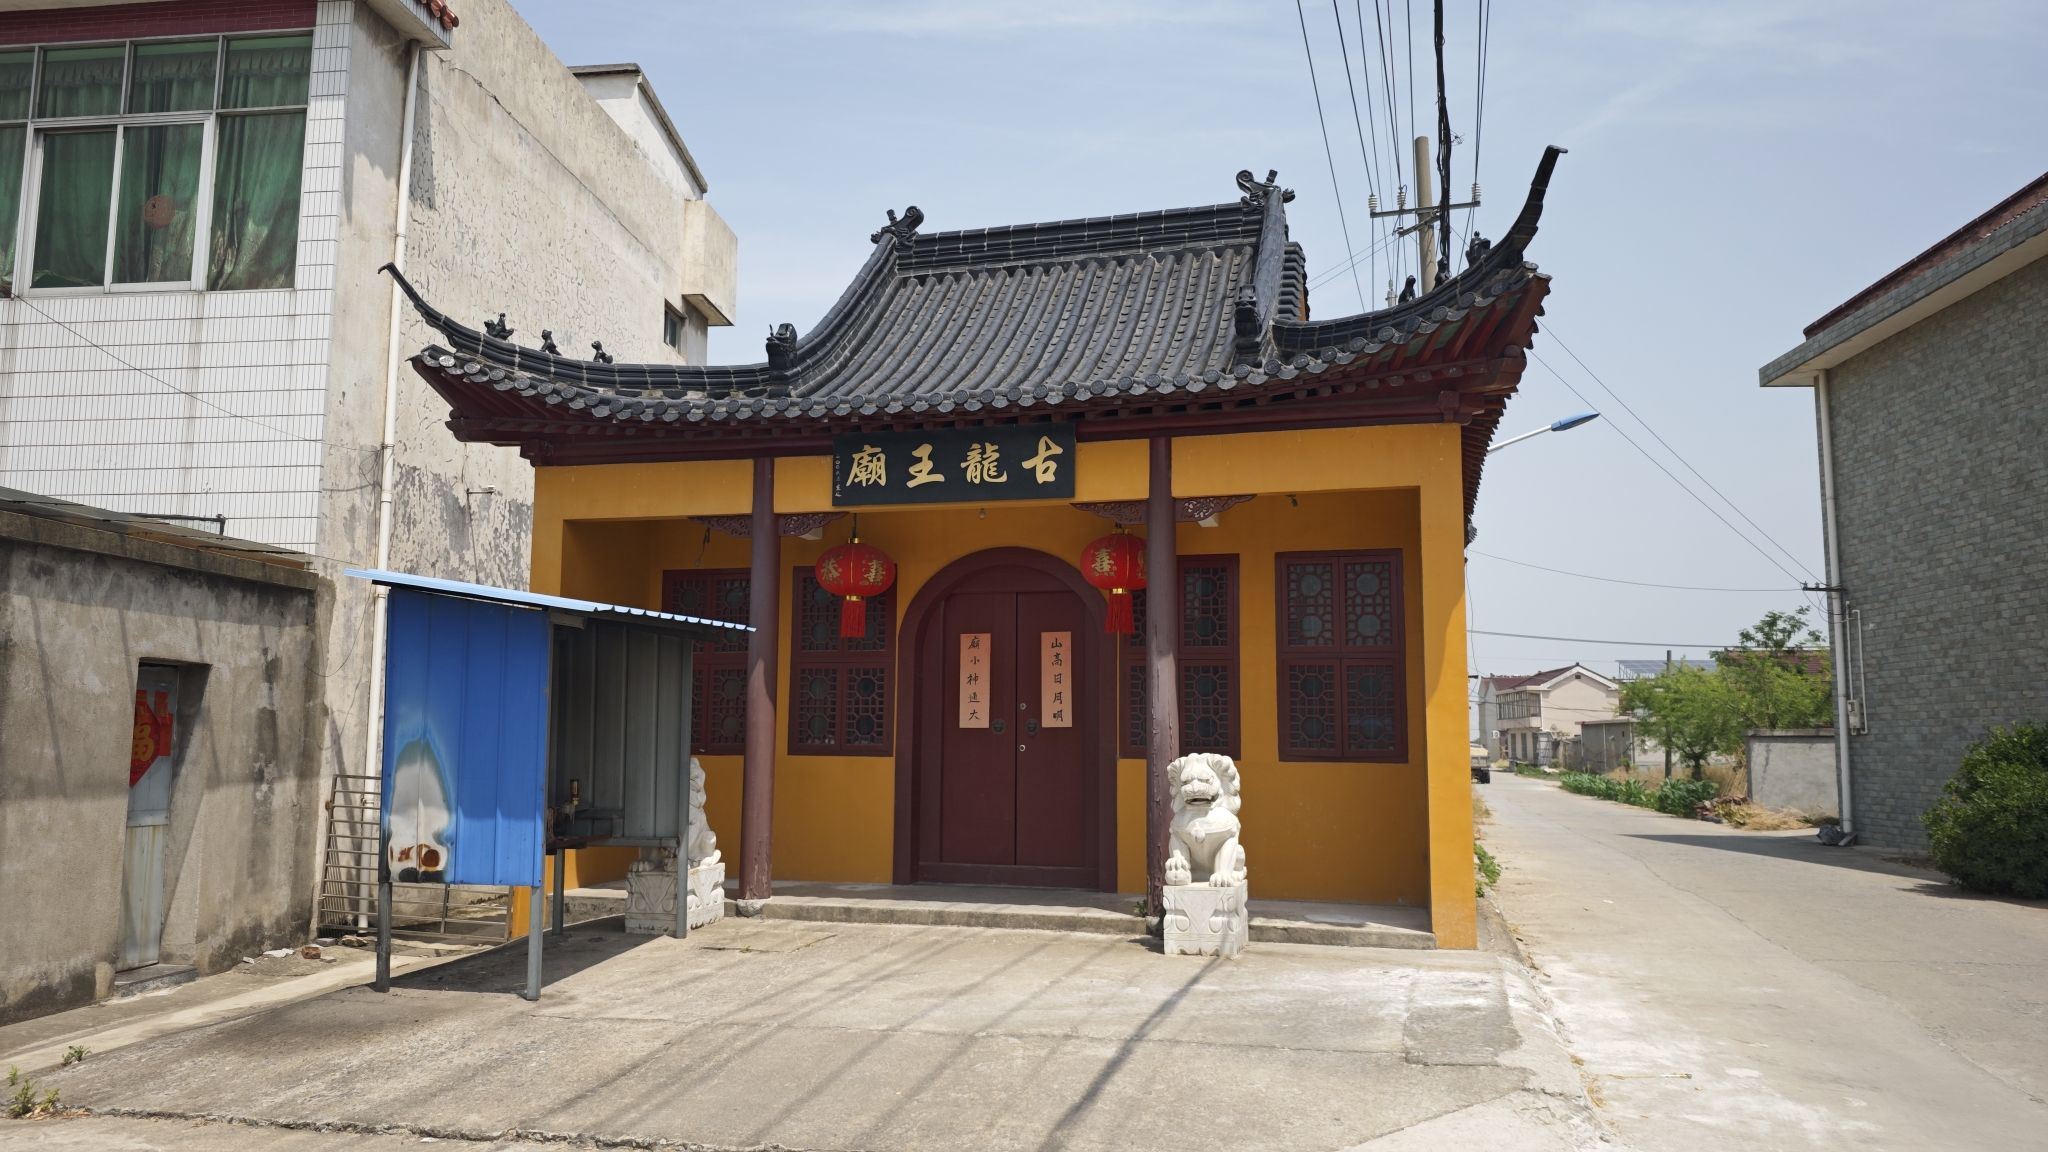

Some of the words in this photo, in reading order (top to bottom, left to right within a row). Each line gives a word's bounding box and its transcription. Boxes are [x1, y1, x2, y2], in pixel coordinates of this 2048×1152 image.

[845, 435, 1064, 488] 古龍王廟
[966, 636, 981, 721] 廟小神通大
[1051, 637, 1064, 722] 山高日月明
